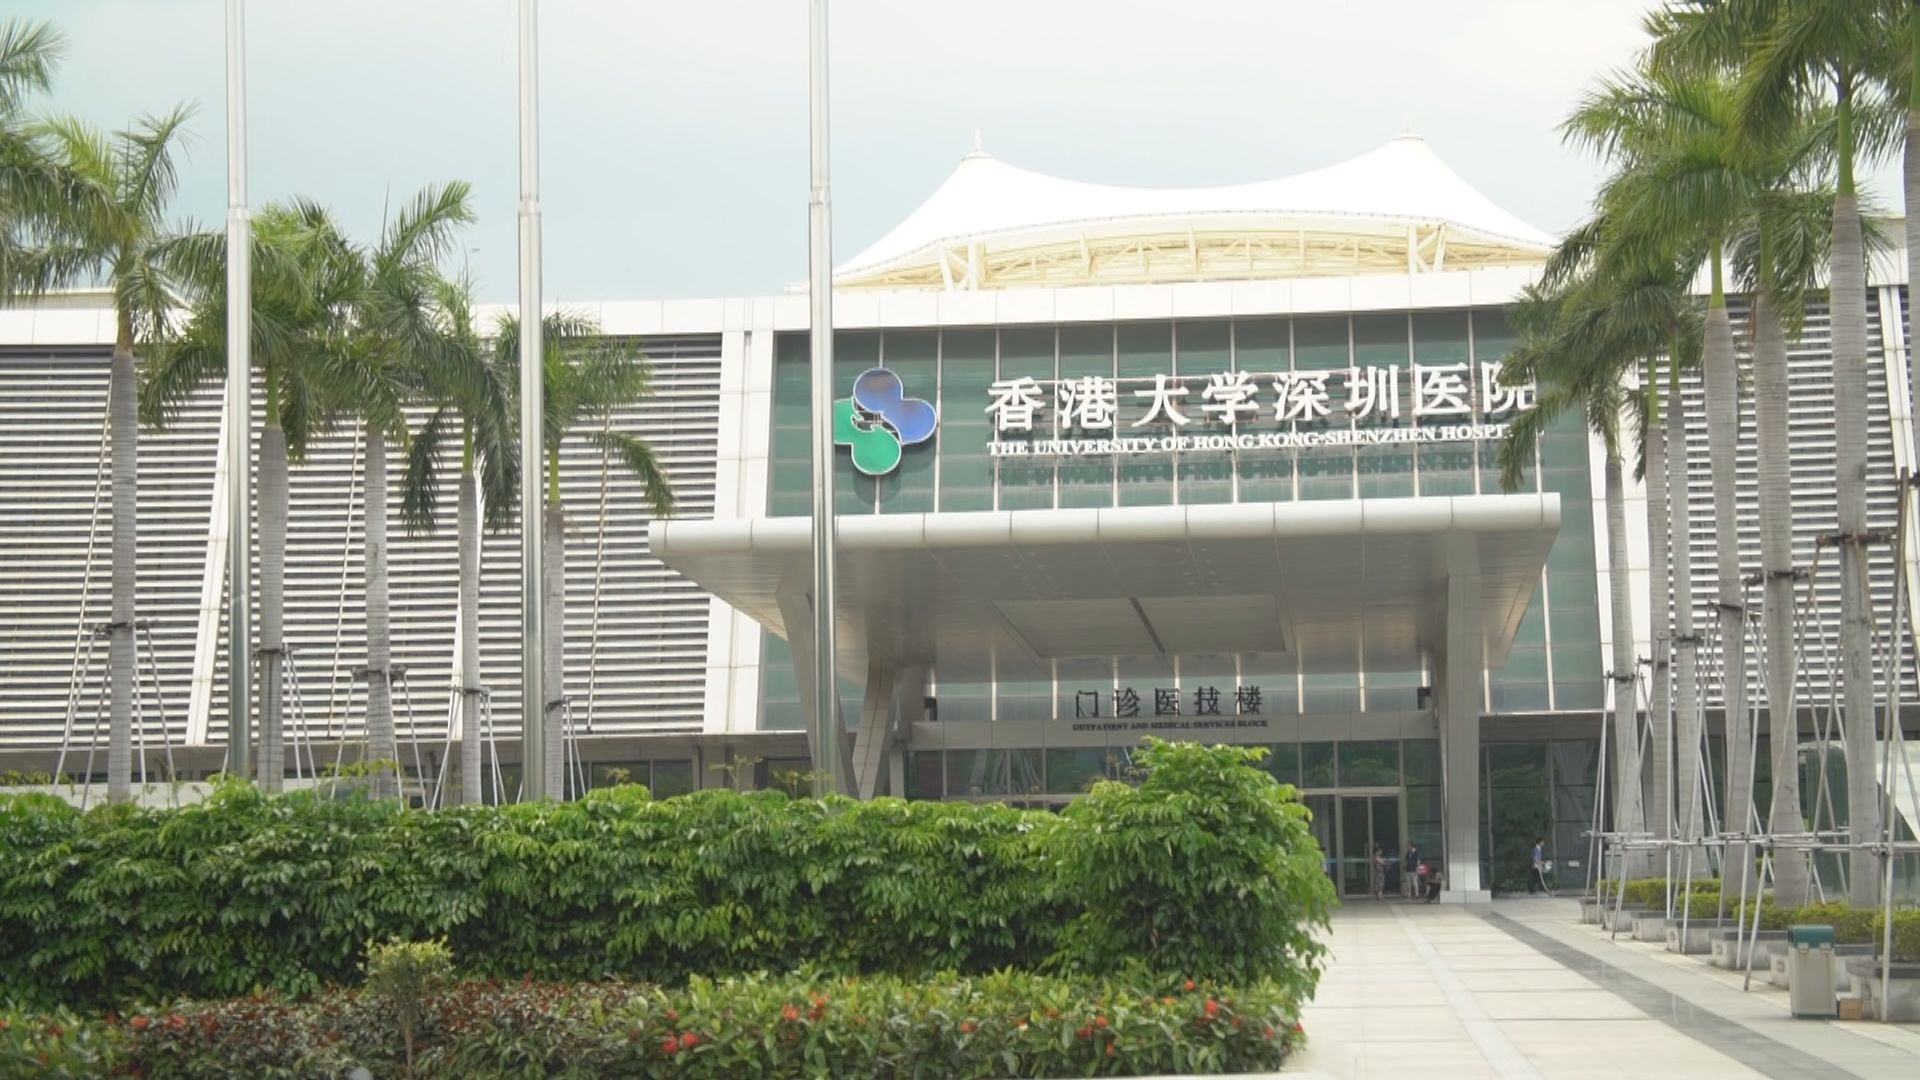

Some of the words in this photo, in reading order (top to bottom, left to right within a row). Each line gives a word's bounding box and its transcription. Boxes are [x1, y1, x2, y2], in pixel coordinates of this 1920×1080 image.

[985, 361, 1538, 432] 香港大学深圳医院
[987, 440, 1029, 456] THE
[1033, 437, 1160, 455] UNIVERSITY
[1160, 435, 1190, 451] OF
[1194, 434, 1255, 451] HONG
[1075, 686, 1262, 719] 门诊医技楼
[1073, 723, 1128, 731] OUTPATIENT
[1193, 721, 1236, 729] SERVICES
